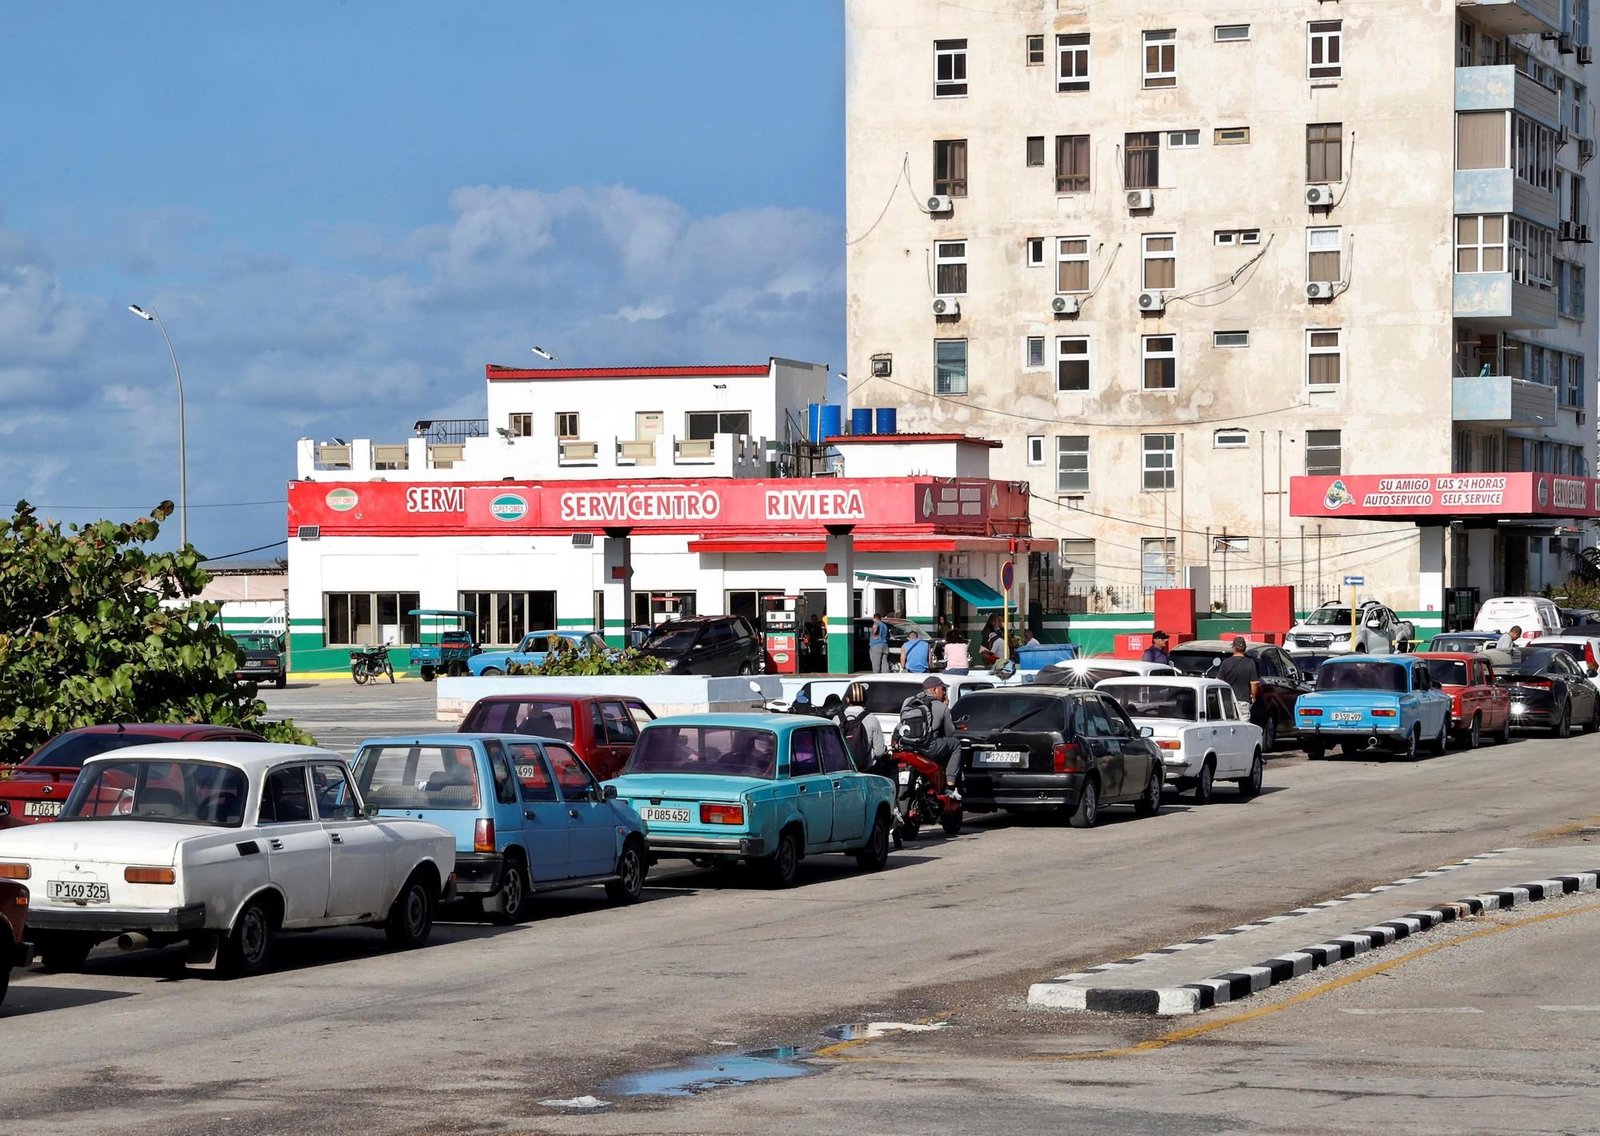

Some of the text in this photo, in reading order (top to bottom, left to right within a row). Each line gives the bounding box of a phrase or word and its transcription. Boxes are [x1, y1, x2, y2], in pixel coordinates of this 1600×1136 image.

[1379, 477, 1505, 491] SU AMIGO LAS 24 HORAS
[562, 492, 863, 518] SERVICENTRO RIVIERA
[1443, 494, 1463, 505] SELF
[1465, 493, 1501, 505] SERVICE
